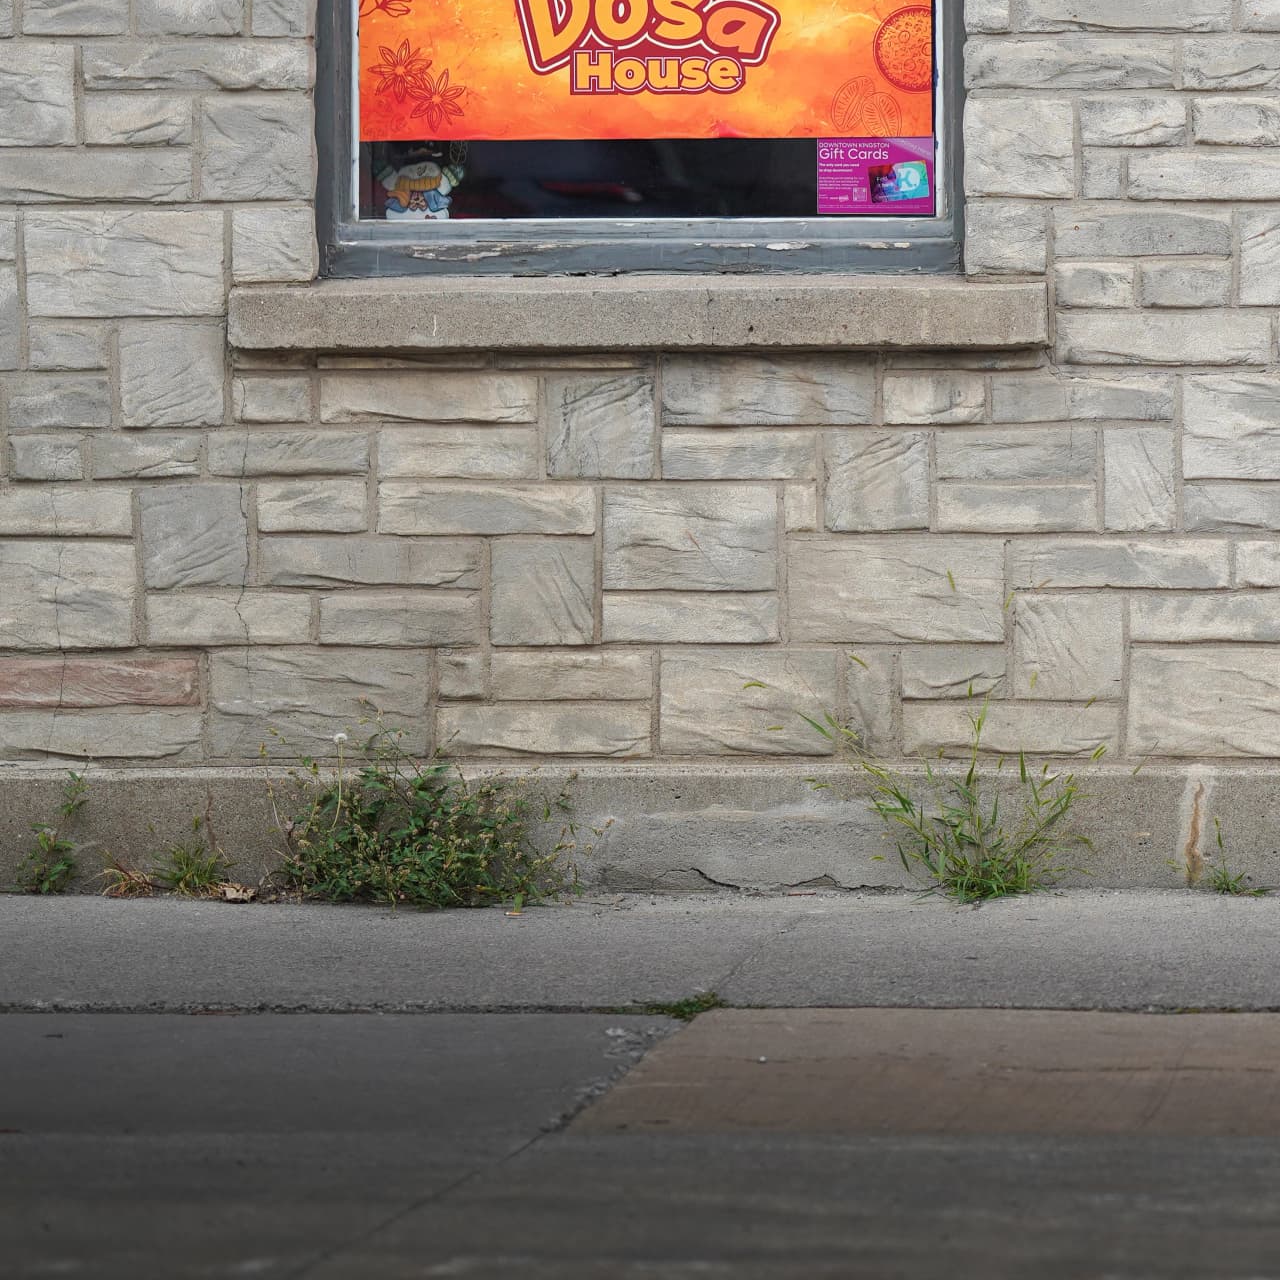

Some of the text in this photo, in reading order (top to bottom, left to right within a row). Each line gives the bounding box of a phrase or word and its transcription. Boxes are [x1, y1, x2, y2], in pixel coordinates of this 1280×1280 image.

[574, 50, 742, 93] House
[819, 148, 889, 160] Gift Cards
